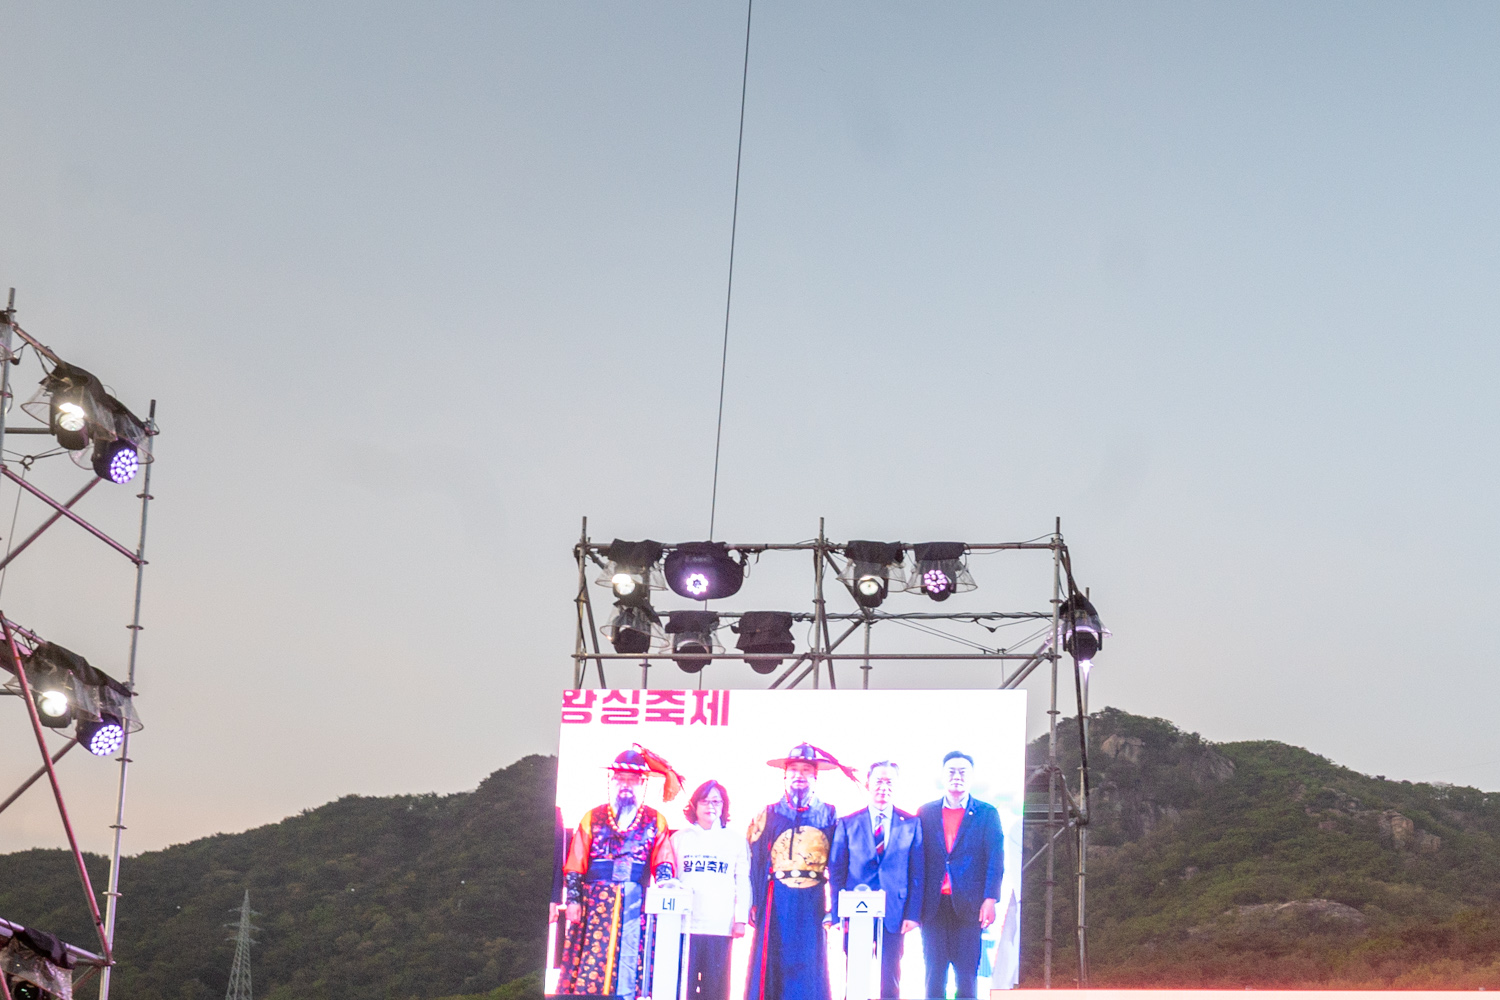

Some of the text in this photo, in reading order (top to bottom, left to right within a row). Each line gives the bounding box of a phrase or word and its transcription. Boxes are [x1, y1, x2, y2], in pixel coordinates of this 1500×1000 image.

[683, 860, 729, 875] 왕실축제
[662, 898, 675, 911] 네
[856, 901, 868, 913] 스
